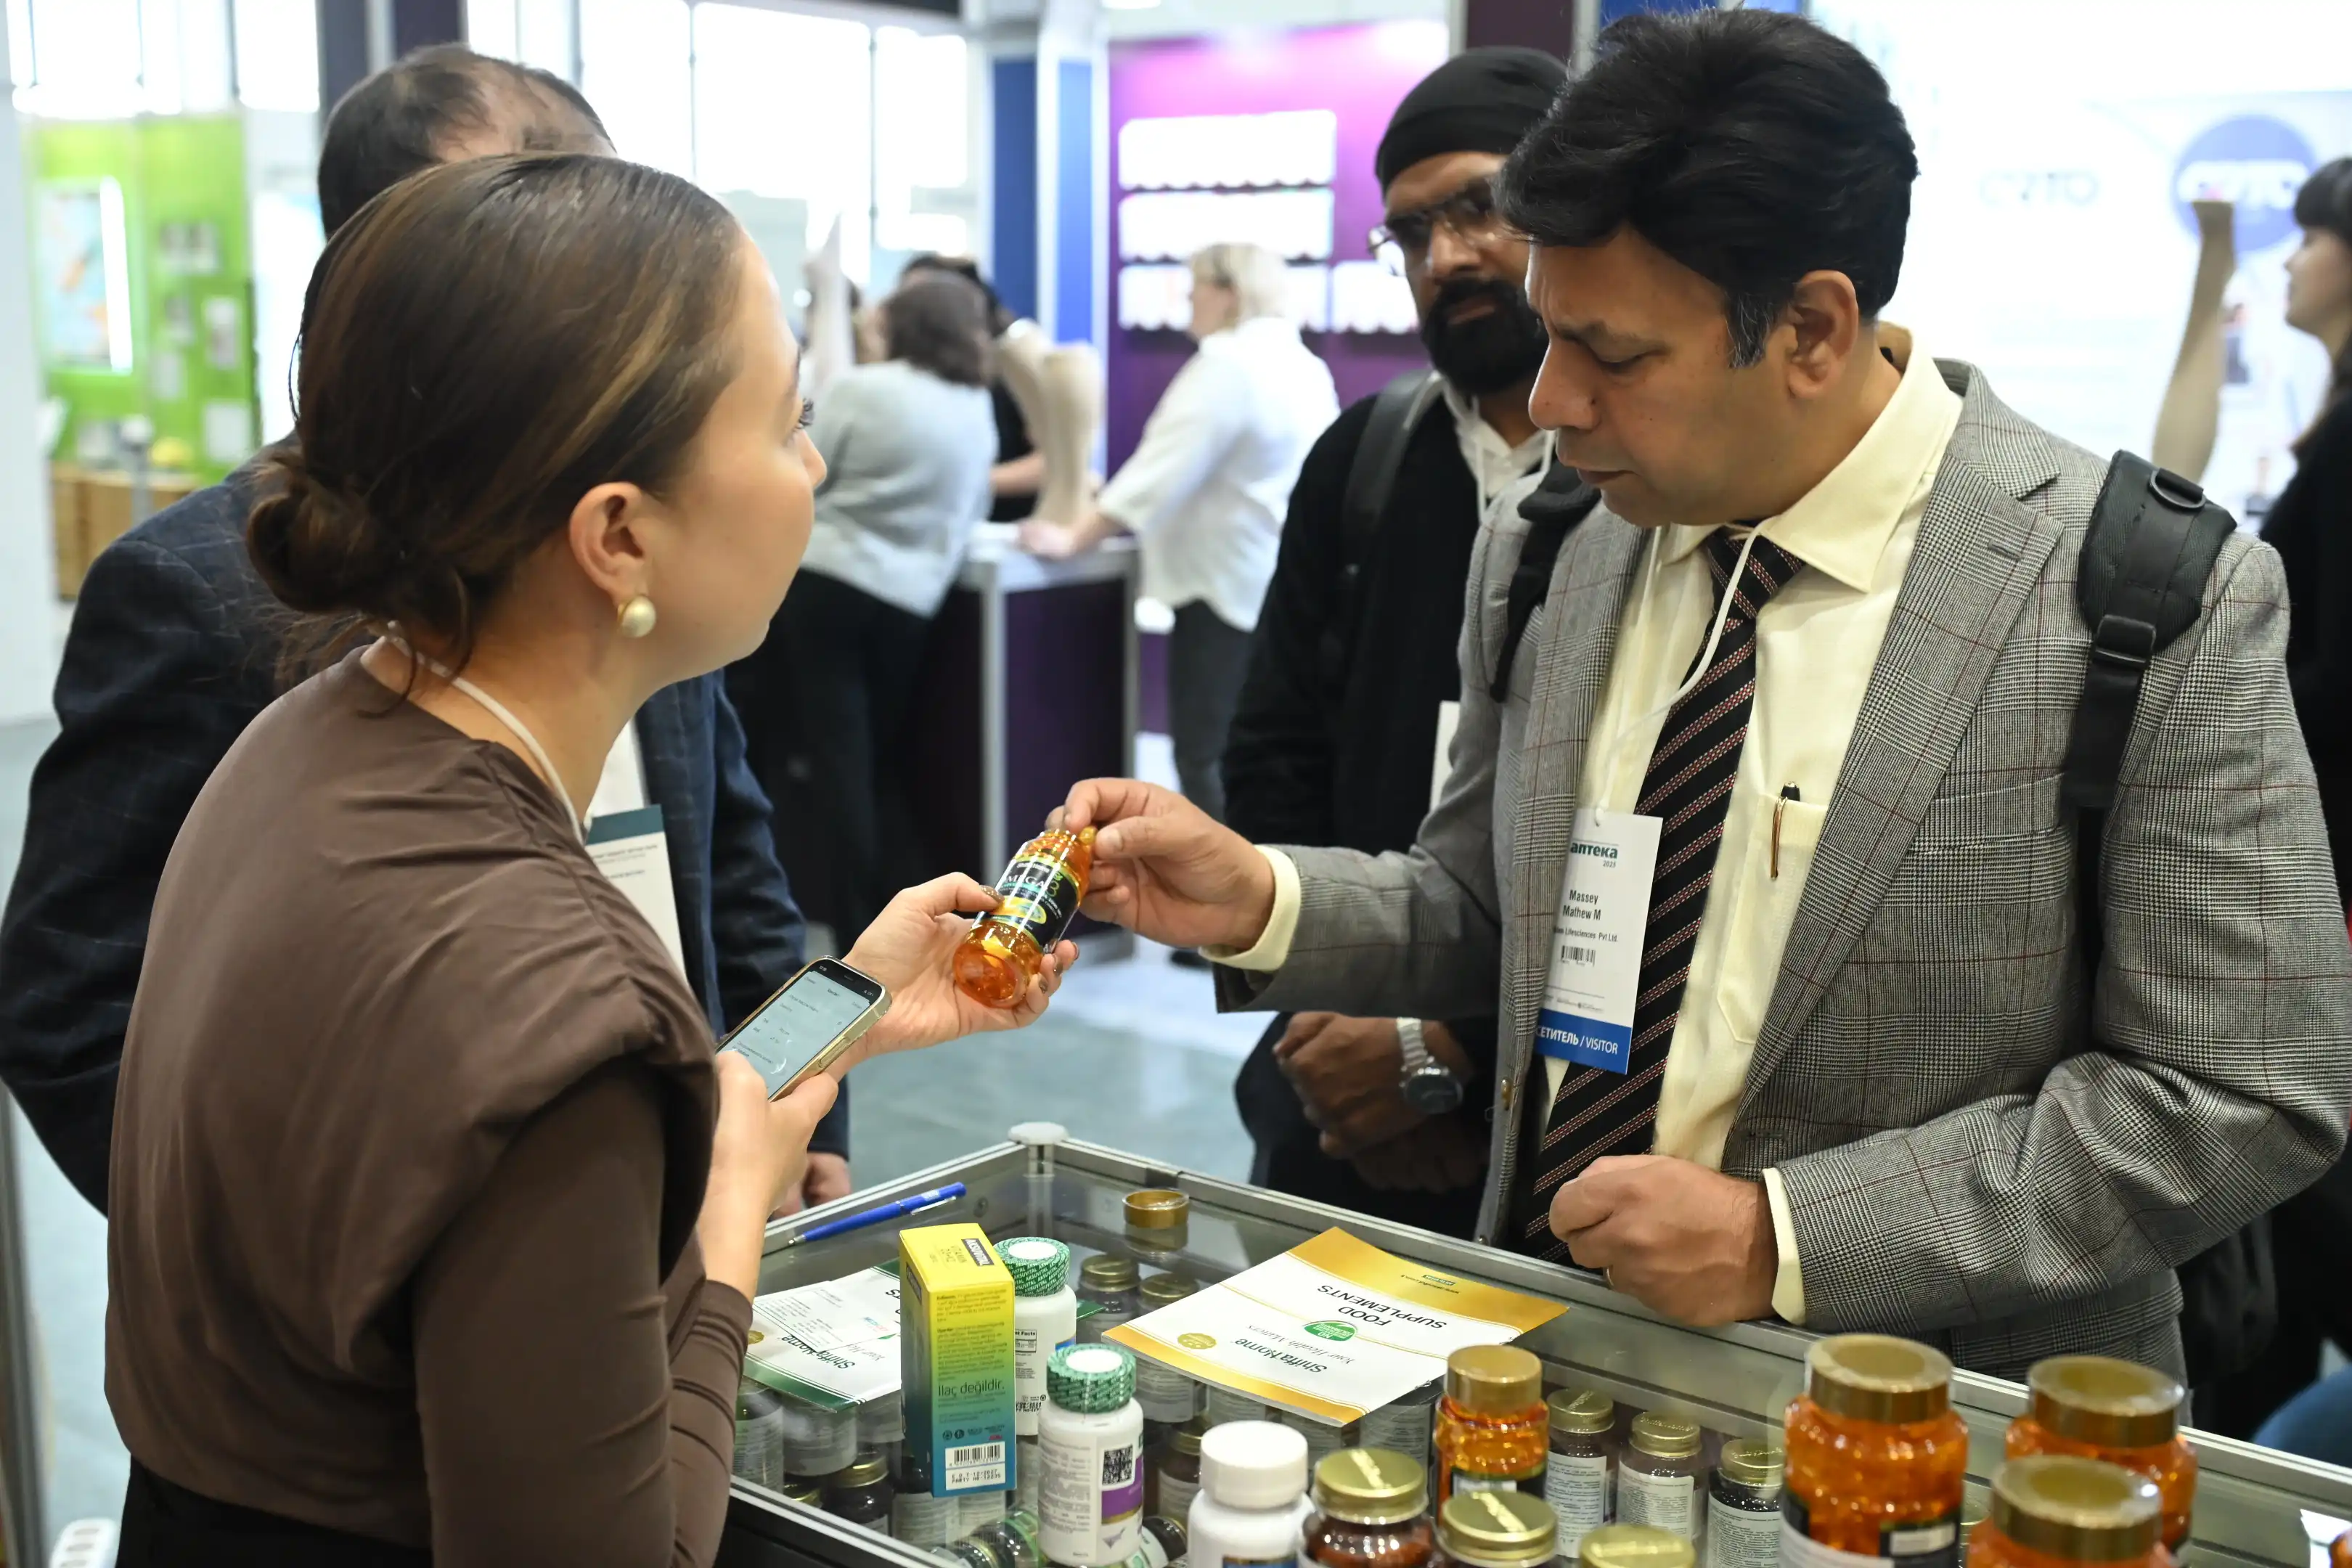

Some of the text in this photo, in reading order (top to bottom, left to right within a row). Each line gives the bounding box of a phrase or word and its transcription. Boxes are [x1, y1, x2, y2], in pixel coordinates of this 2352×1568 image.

[1570, 842, 1618, 859] аптека
[1569, 889, 1598, 905] Massey
[1562, 905, 1601, 920] Mathew M
[1565, 927, 1596, 939] Lifesciences
[1598, 932, 1607, 941] Pvt
[1535, 1026, 1579, 1045] СЕТИТЕЛЬ
[1585, 1037, 1618, 1055] VISITOR
[1317, 1284, 1447, 1329] SUPPLEMENTS
[1338, 1306, 1392, 1327] FOOD
[1246, 1324, 1355, 1365] Your Health Matters
